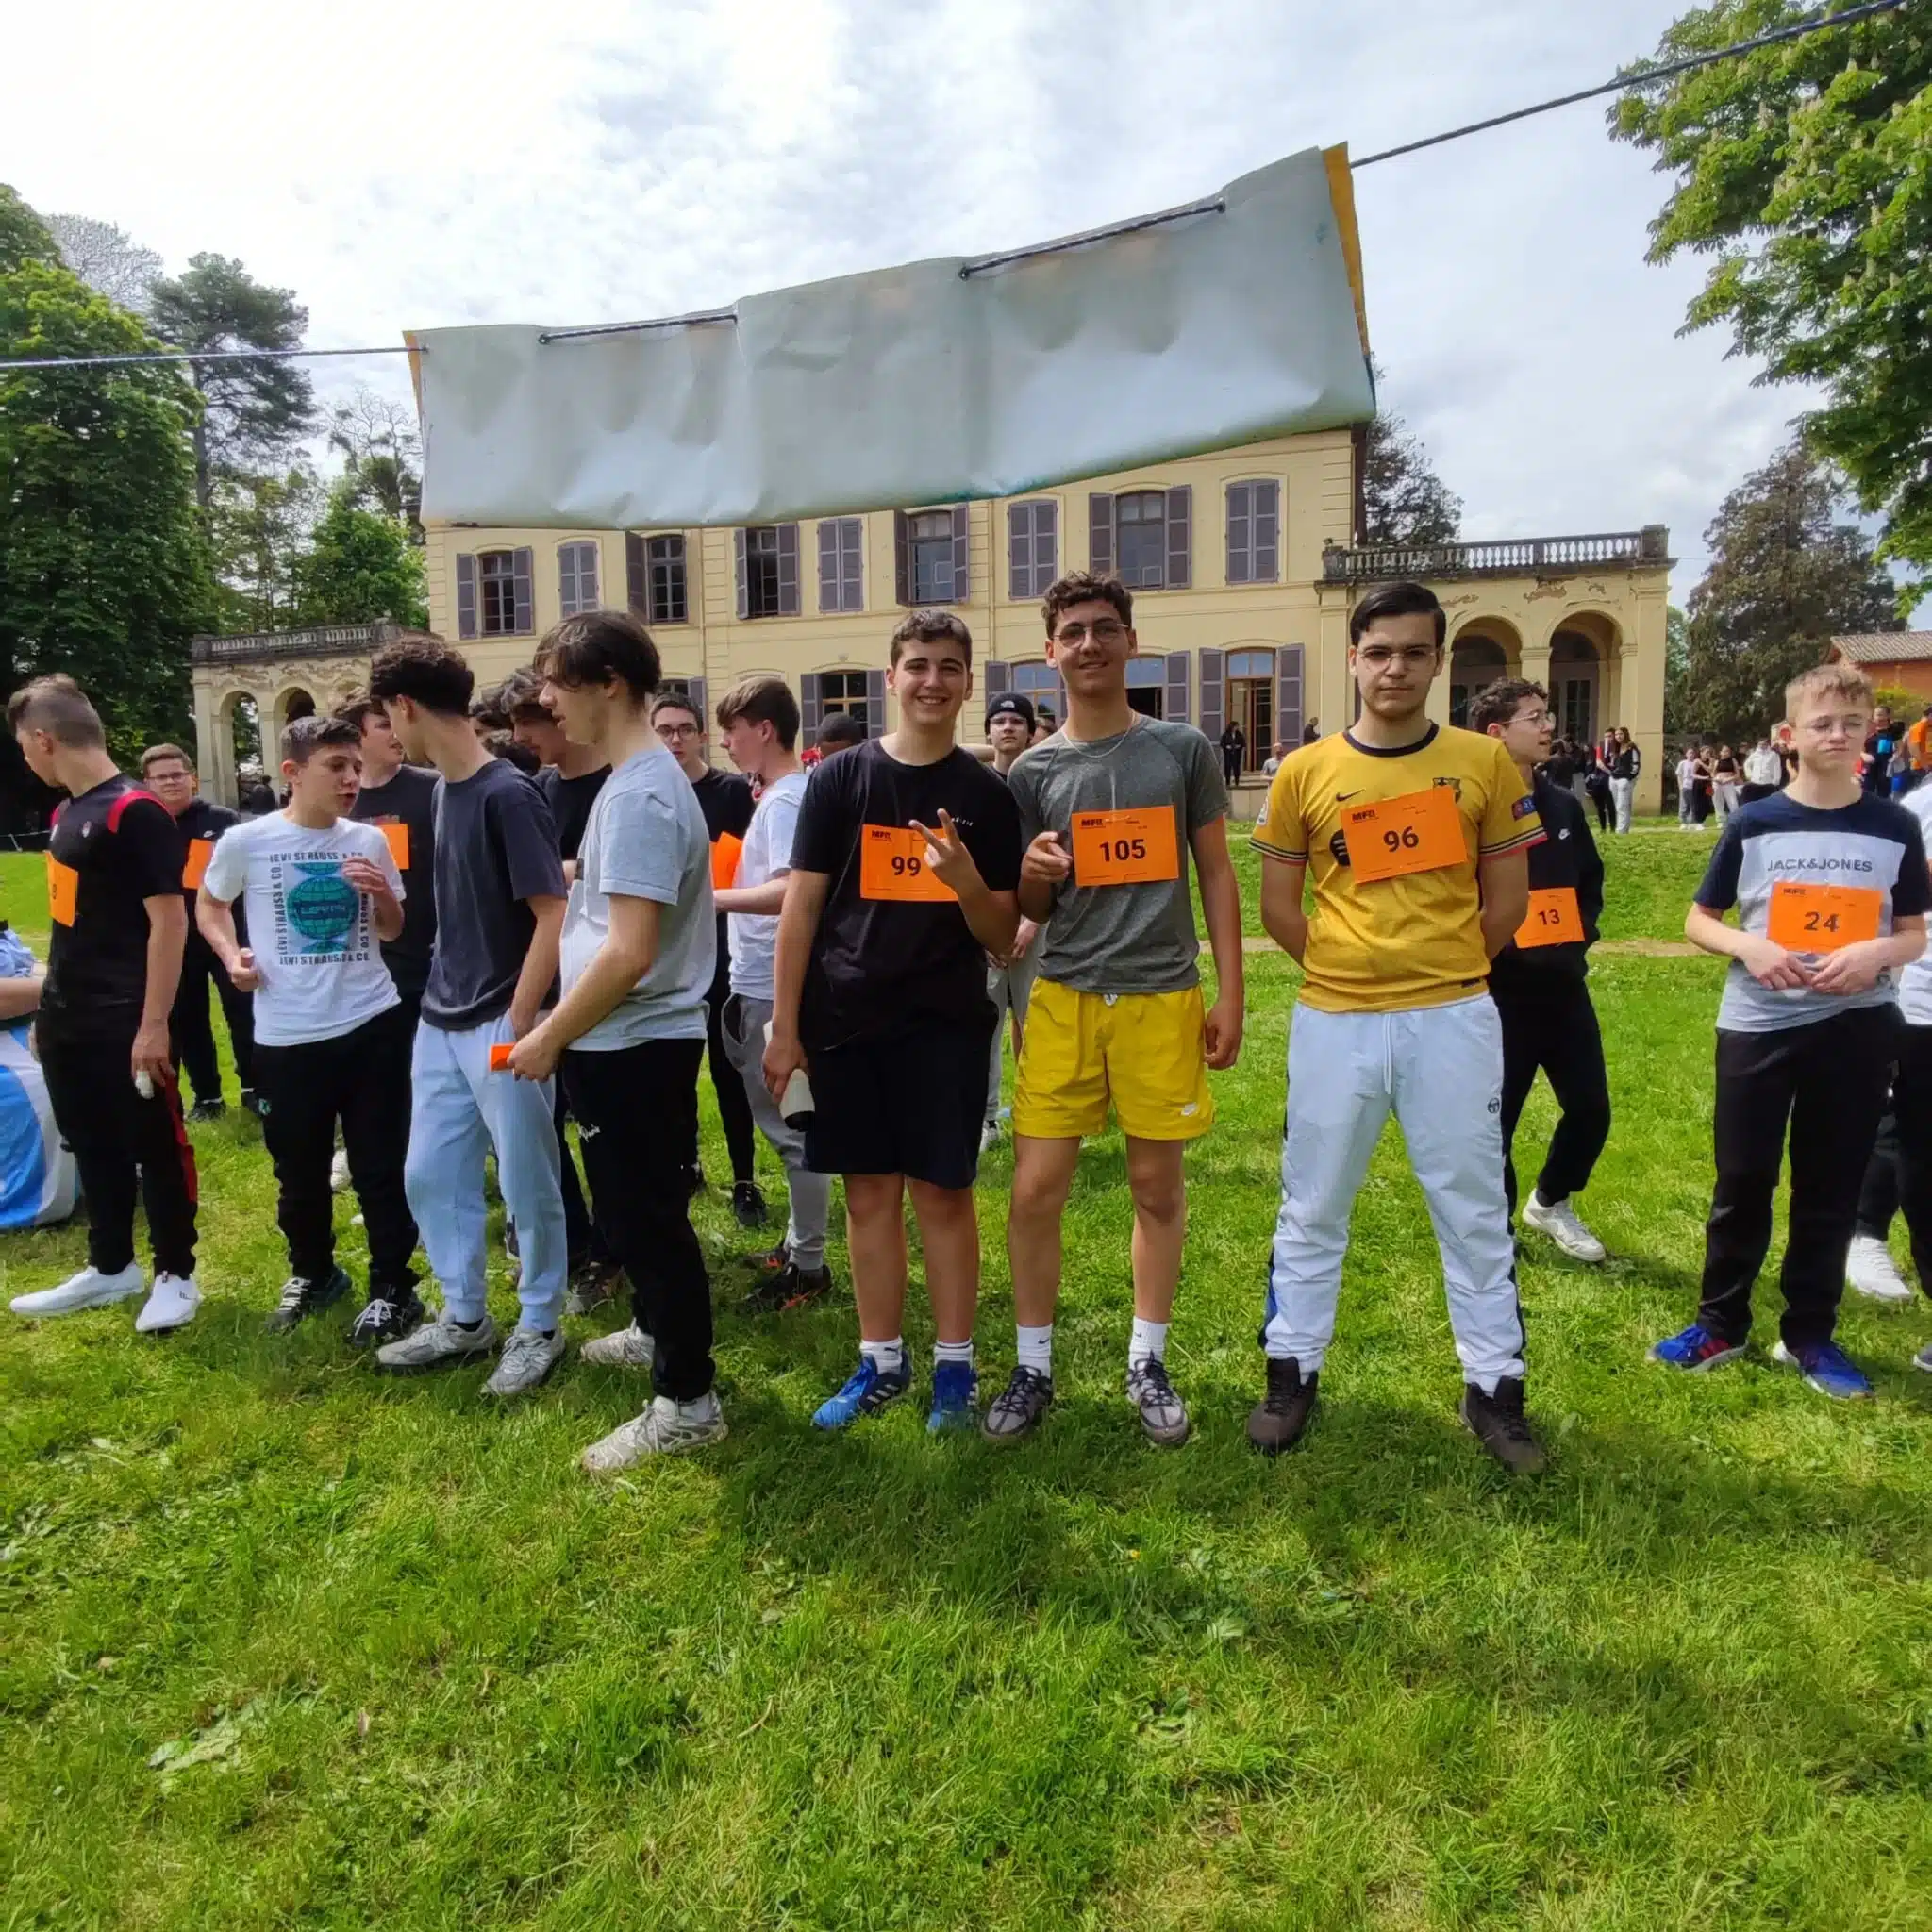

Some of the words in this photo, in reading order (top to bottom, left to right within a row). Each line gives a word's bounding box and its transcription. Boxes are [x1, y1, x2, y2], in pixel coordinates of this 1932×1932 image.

[1383, 826, 1419, 852] 96
[1099, 839, 1146, 862] 105
[891, 856, 921, 876] 99
[1768, 858, 1873, 873] JACK&JONES
[1538, 908, 1560, 925] 13
[1804, 911, 1840, 932] 24
